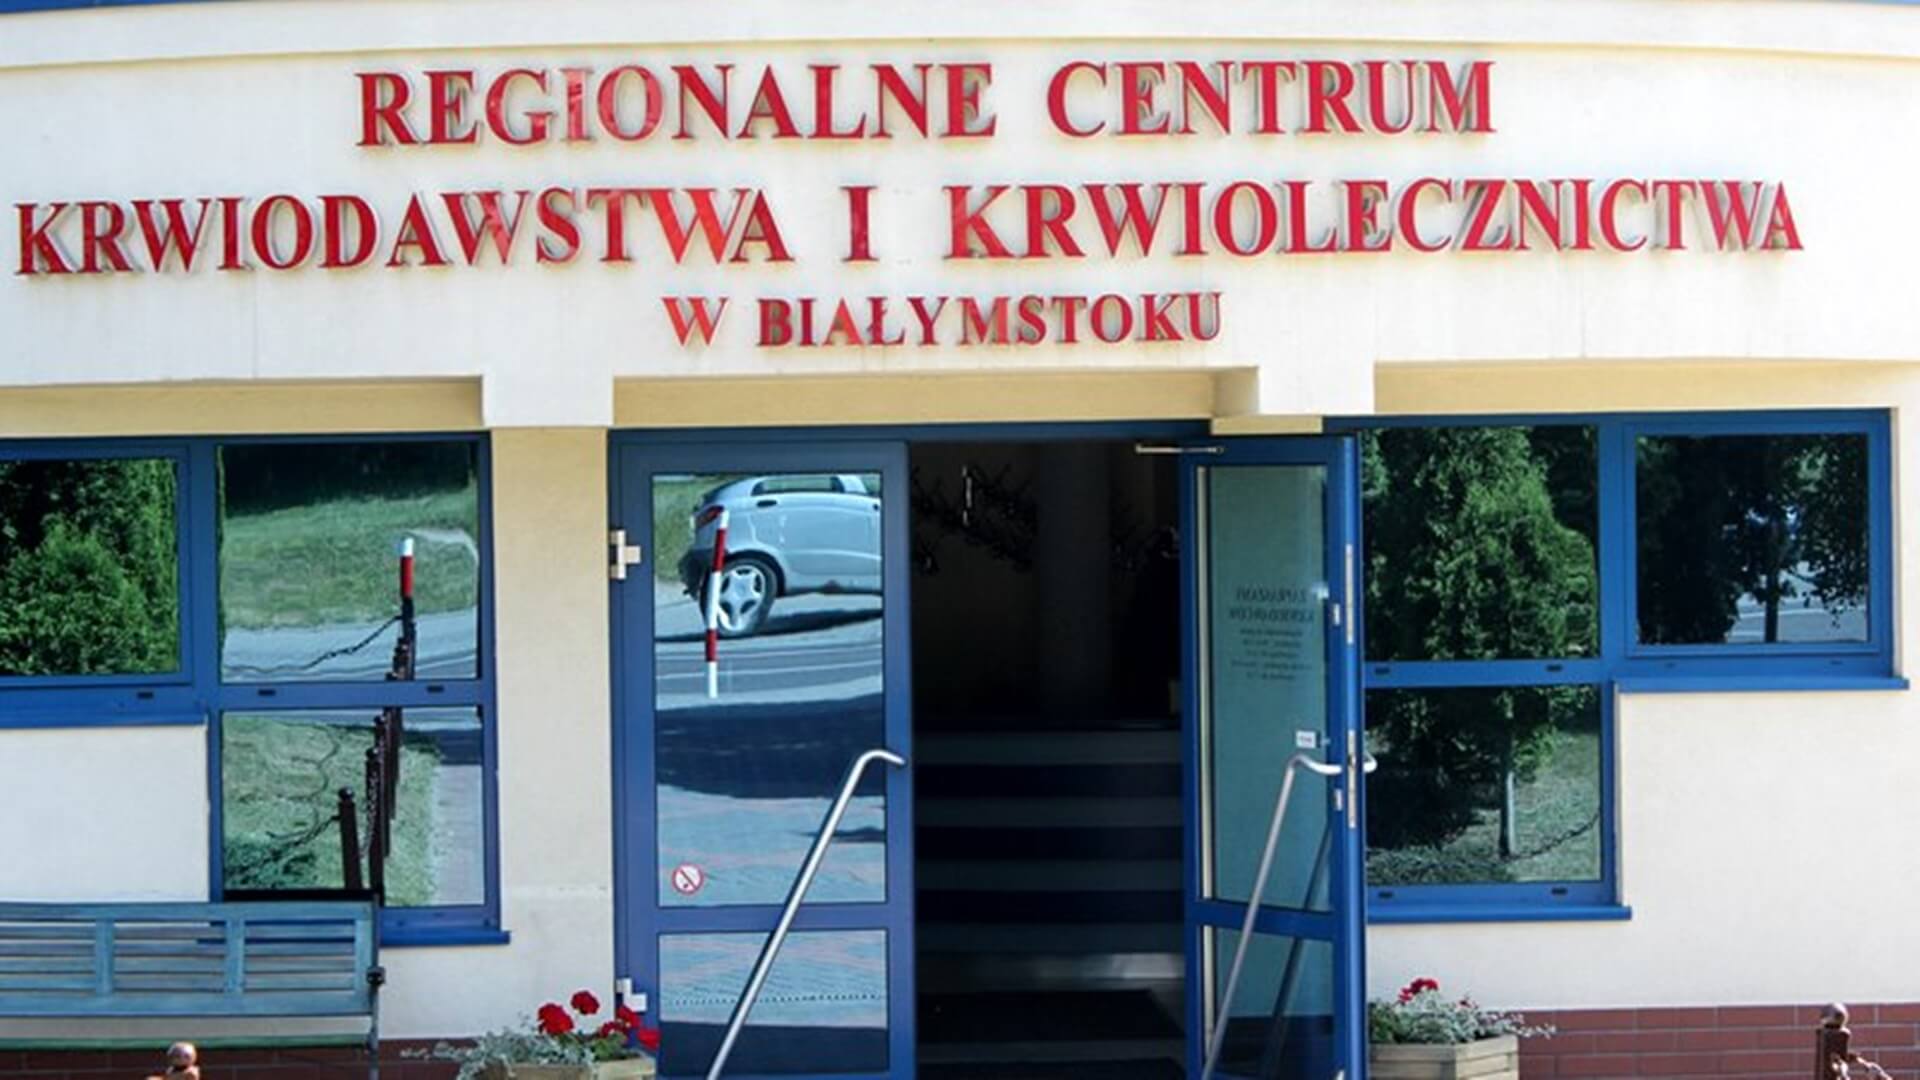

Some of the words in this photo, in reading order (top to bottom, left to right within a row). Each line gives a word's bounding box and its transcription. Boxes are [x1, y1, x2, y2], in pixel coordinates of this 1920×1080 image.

[358, 63, 997, 149] REGIONALNE
[1046, 60, 1496, 137] CENTRUM
[15, 186, 795, 275] KRWIODAWSTWA
[842, 184, 879, 262] I
[946, 177, 1806, 262] KRWIOLECZNICTWA
[661, 296, 729, 347] W
[757, 291, 1224, 348] BIAŁYMSTOKU
